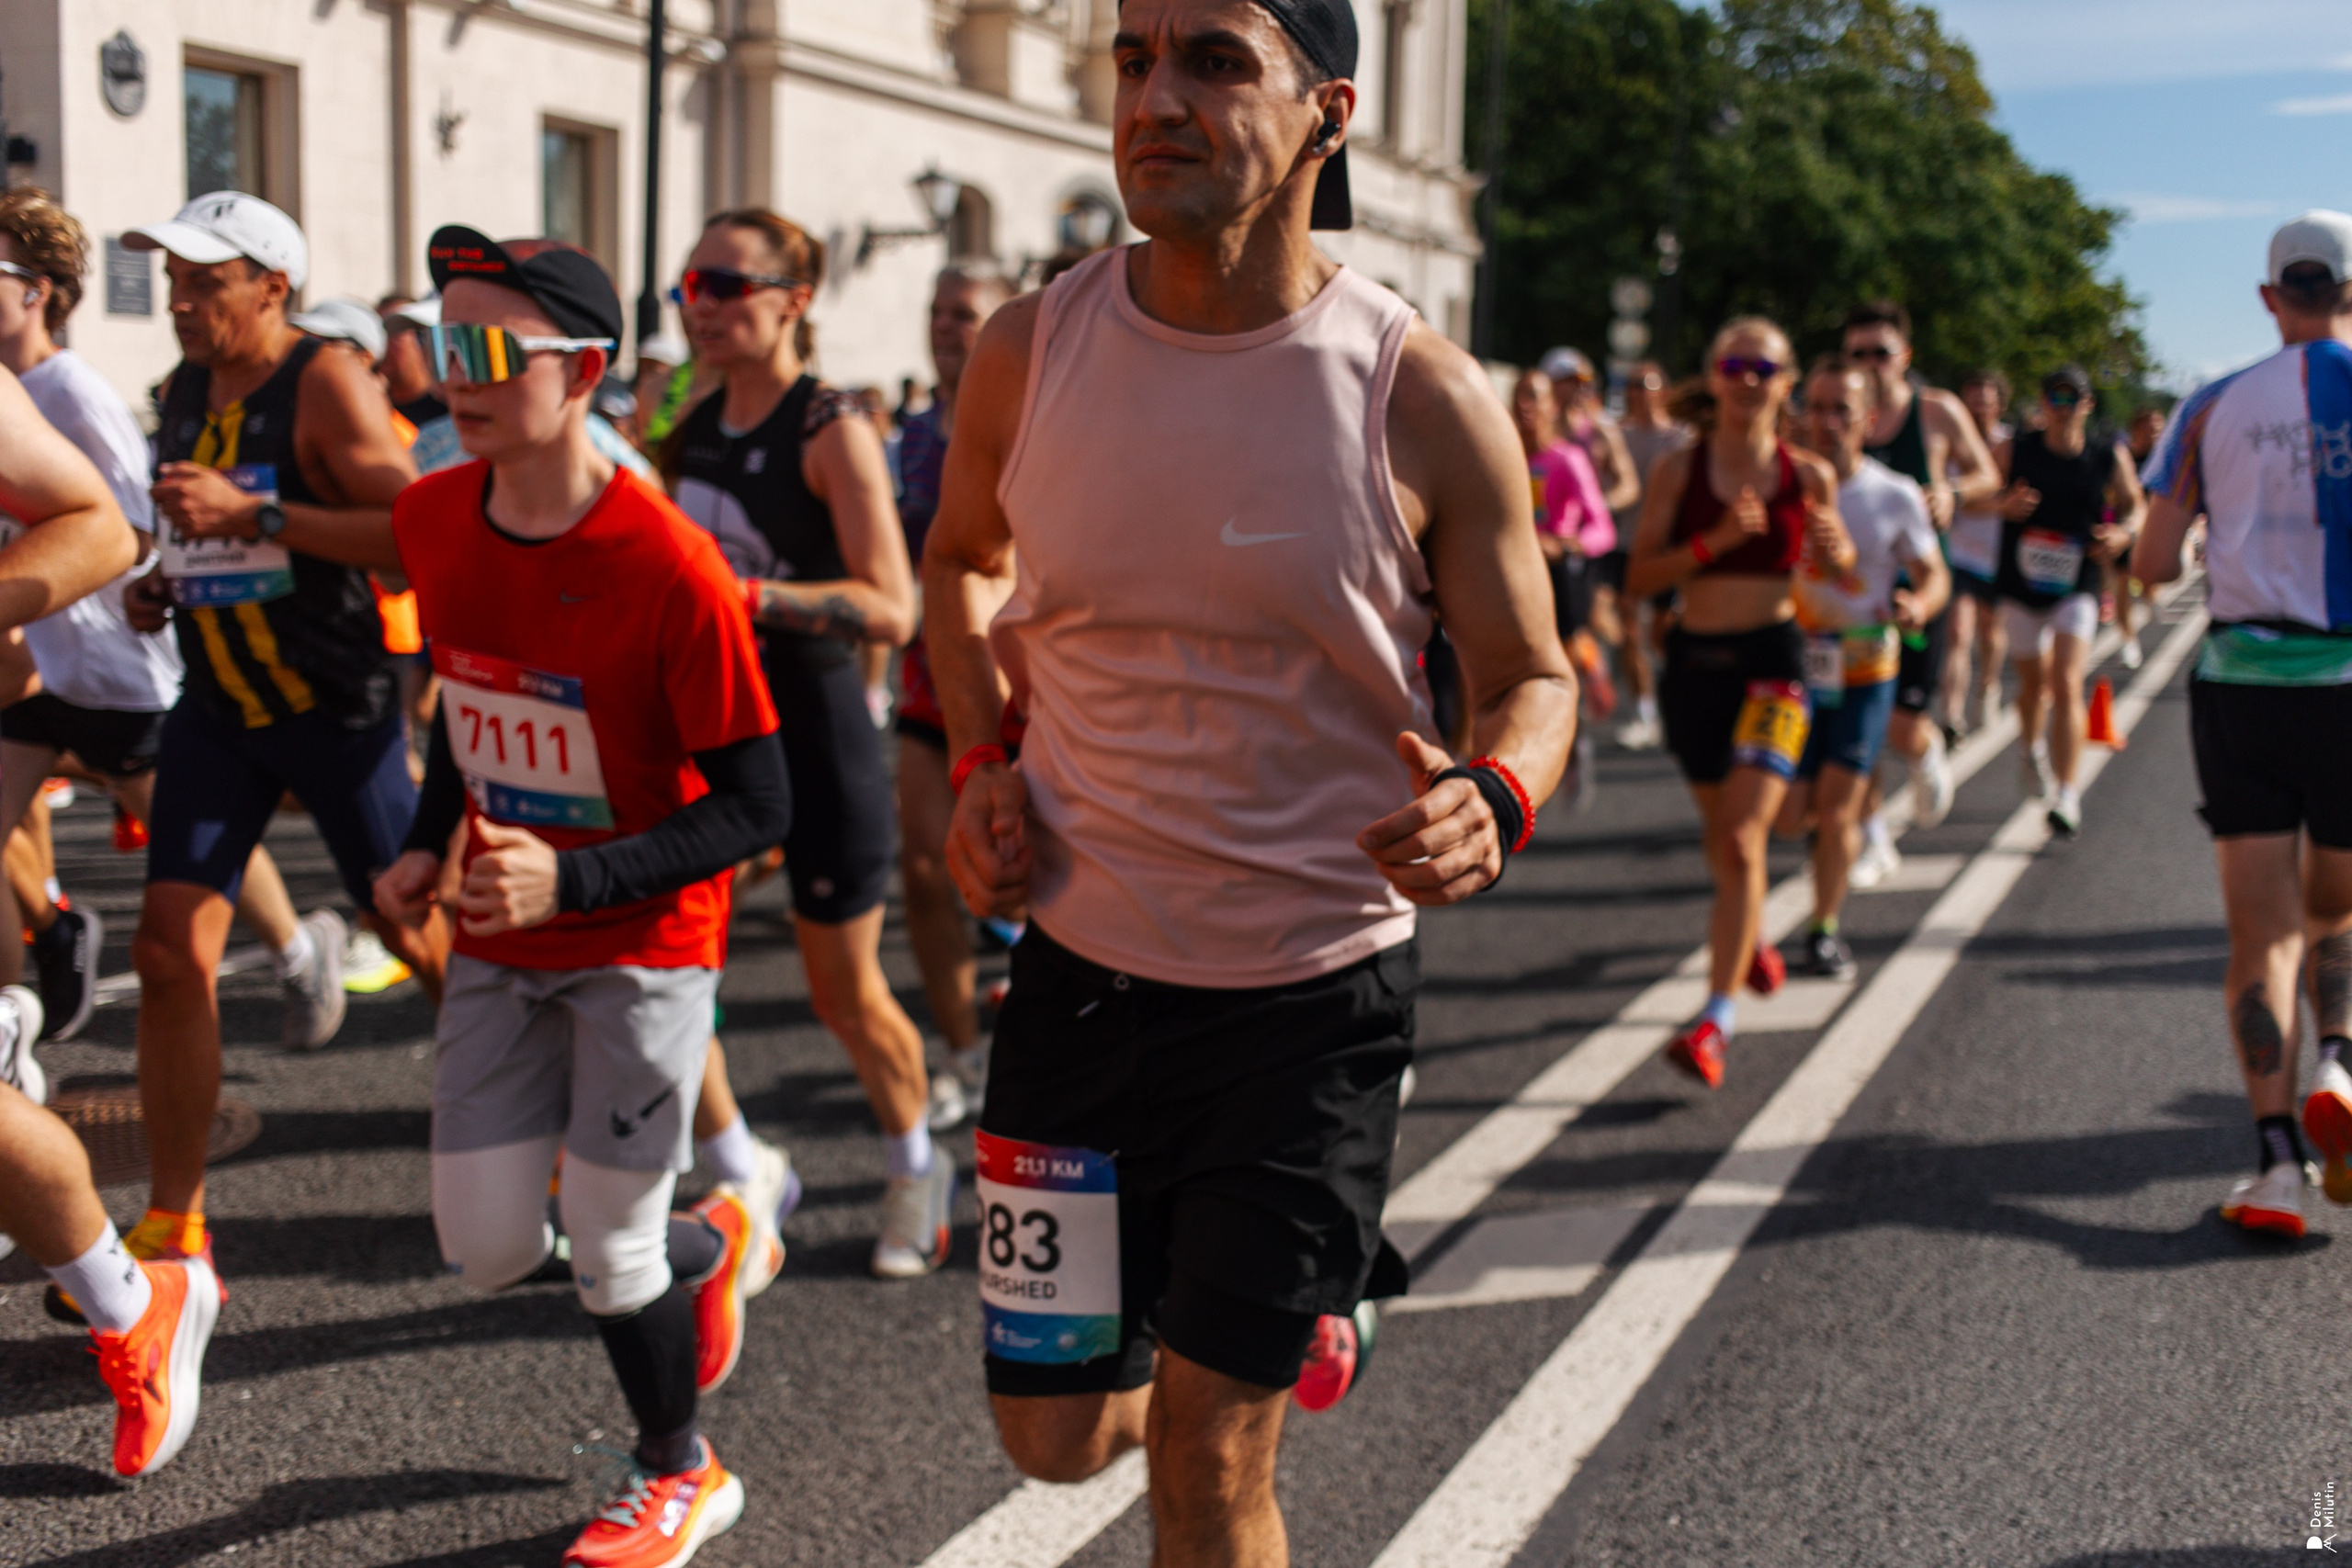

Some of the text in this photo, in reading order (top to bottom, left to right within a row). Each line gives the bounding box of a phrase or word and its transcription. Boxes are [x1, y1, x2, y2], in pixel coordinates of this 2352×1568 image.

[459, 705, 570, 775] 7111
[1051, 1159, 1088, 1181] KM
[978, 1194, 1062, 1274] 83
[980, 1271, 1057, 1300] URSHED
